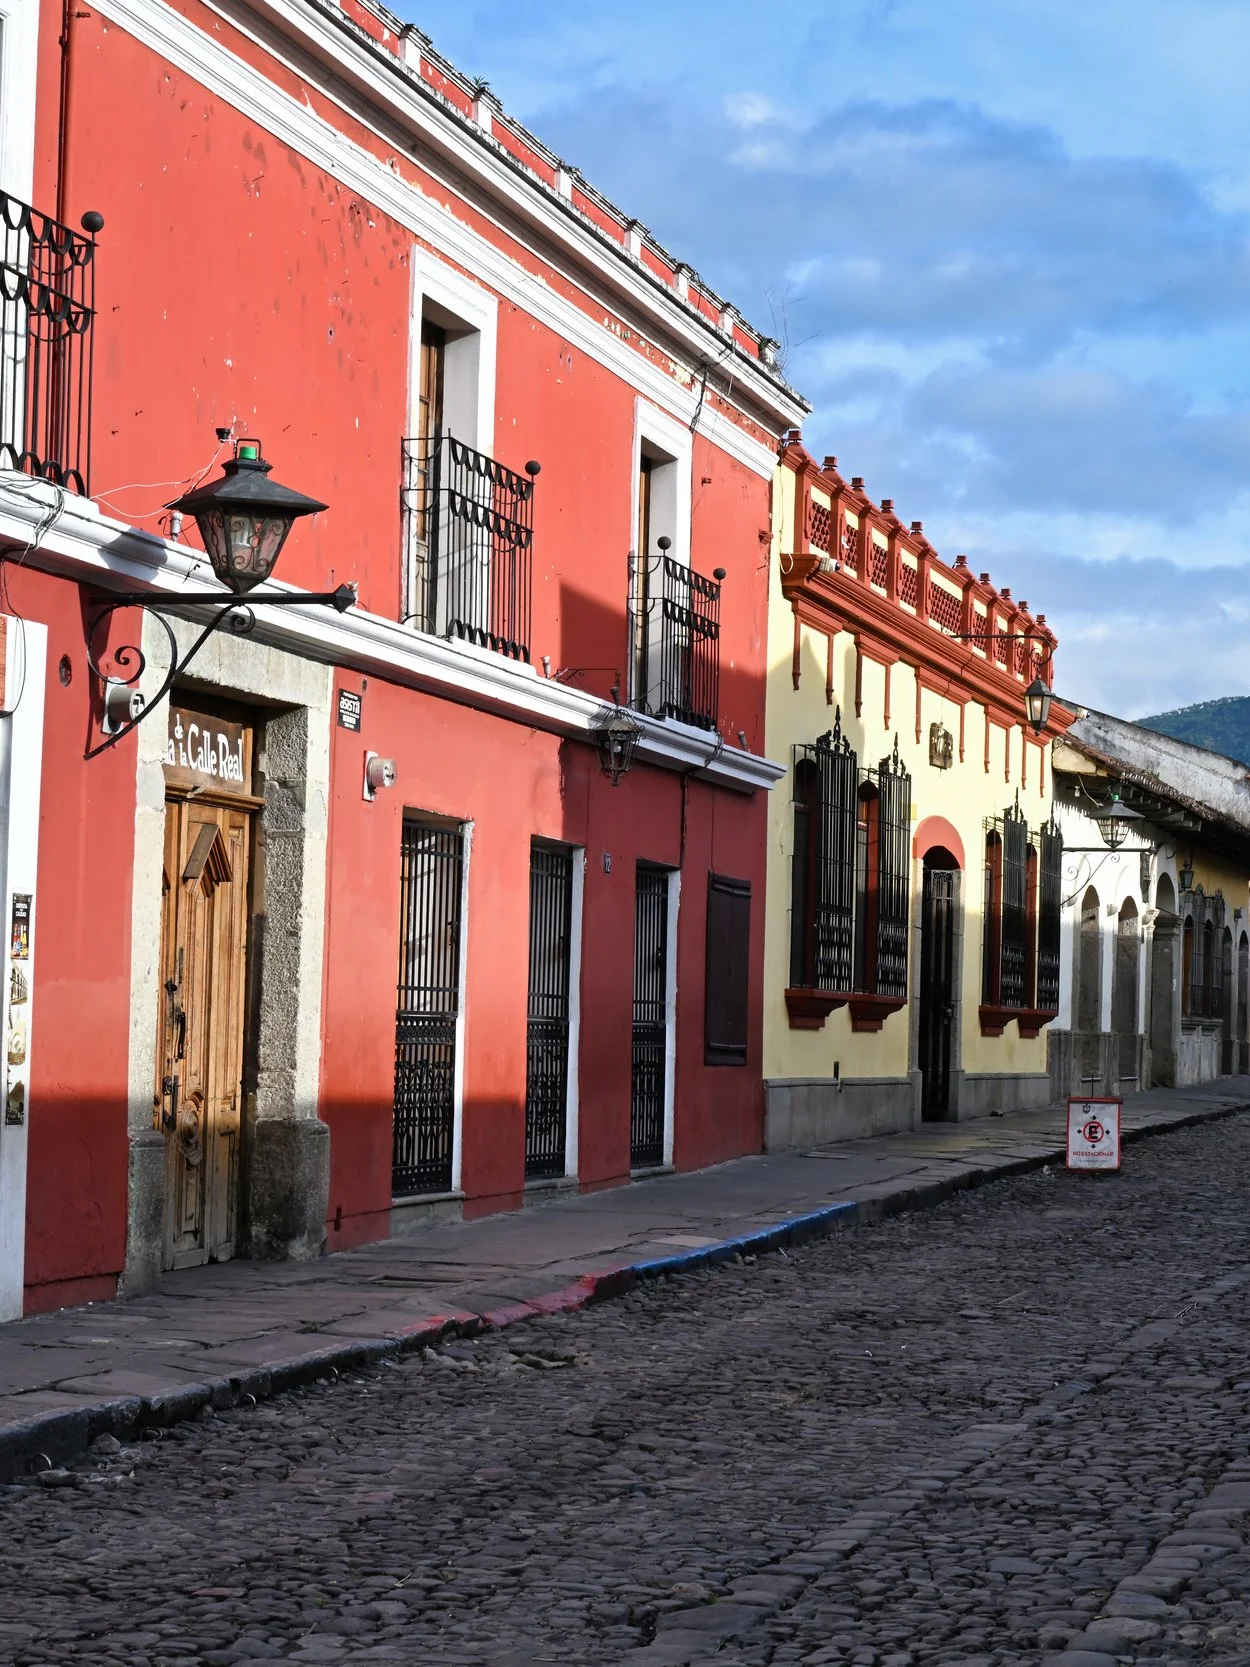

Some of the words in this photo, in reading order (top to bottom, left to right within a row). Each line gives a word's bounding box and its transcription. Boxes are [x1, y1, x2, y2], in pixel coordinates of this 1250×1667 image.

[174, 713, 184, 739] de
[179, 742, 188, 767] la
[187, 723, 217, 776] Calle
[217, 733, 244, 782] Real
